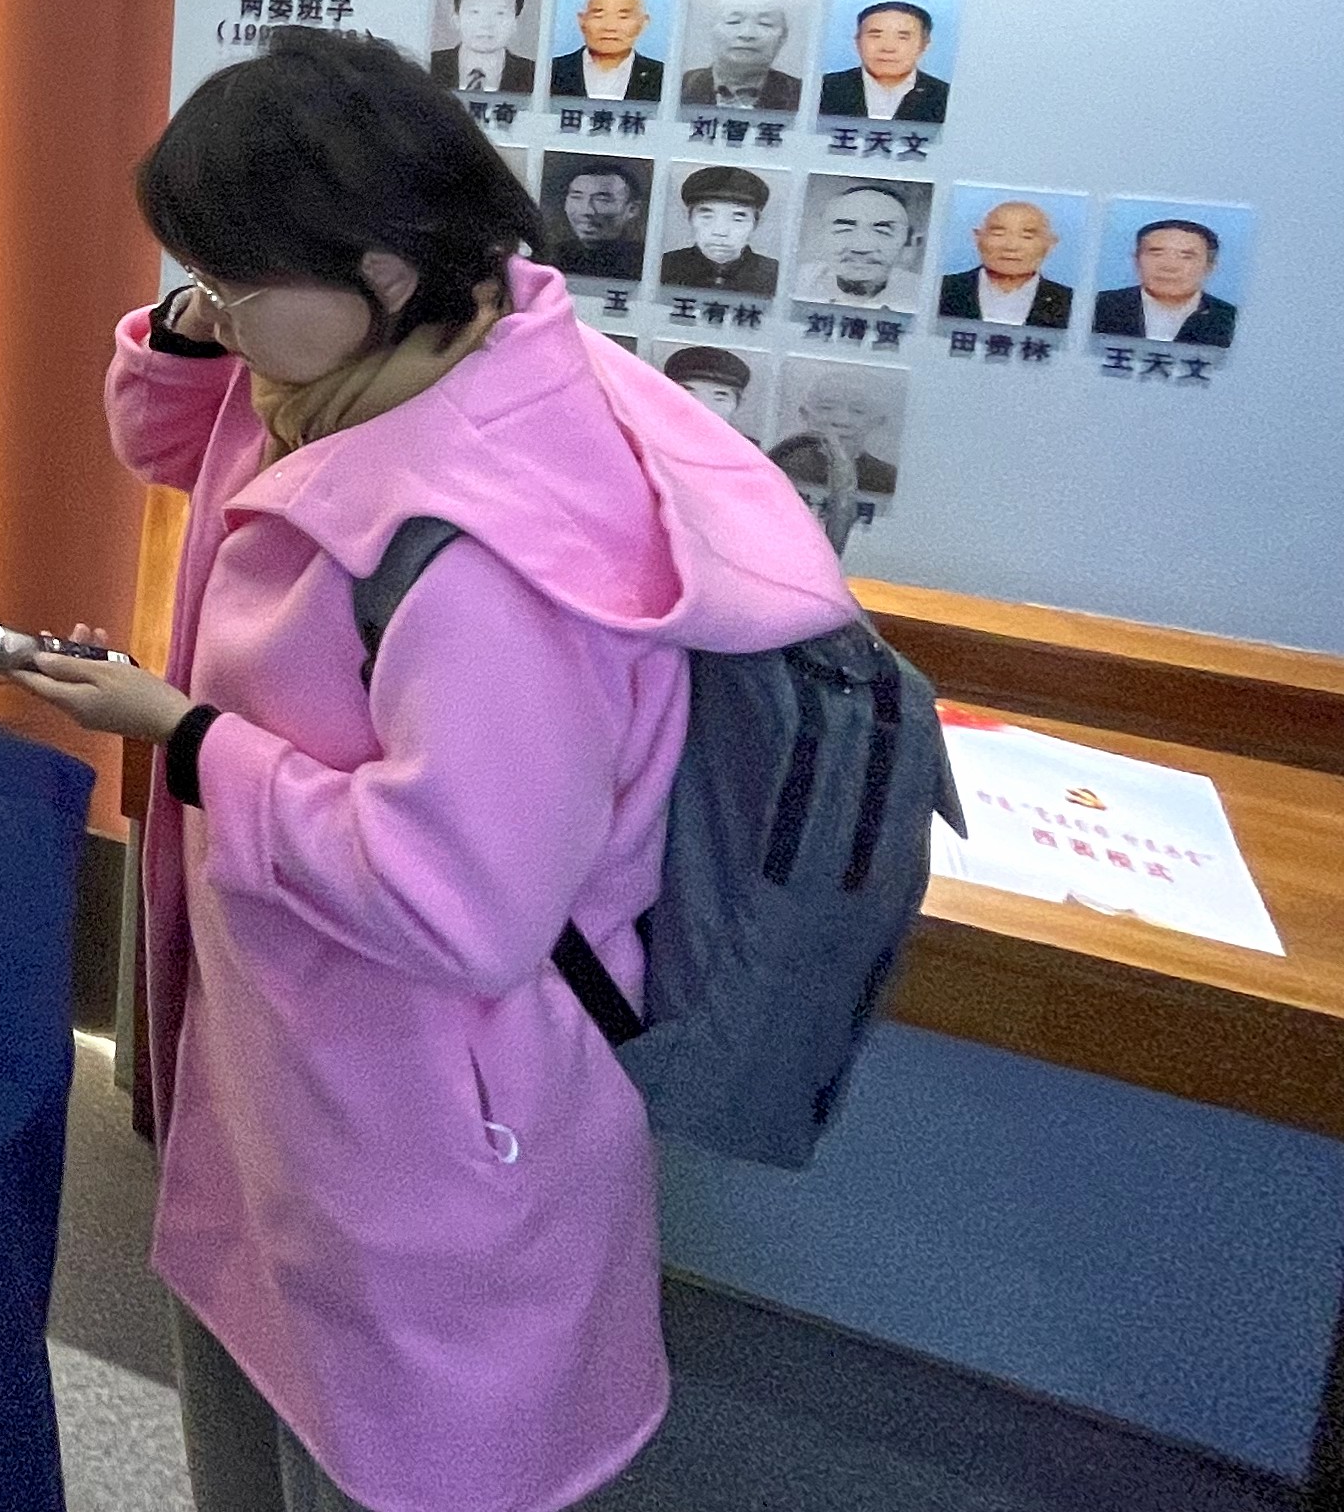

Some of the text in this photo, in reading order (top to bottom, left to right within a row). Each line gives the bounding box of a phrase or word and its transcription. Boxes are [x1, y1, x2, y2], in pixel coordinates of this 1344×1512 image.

[829, 127, 929, 160] 王天文
[1103, 346, 1212, 380] 王天文
